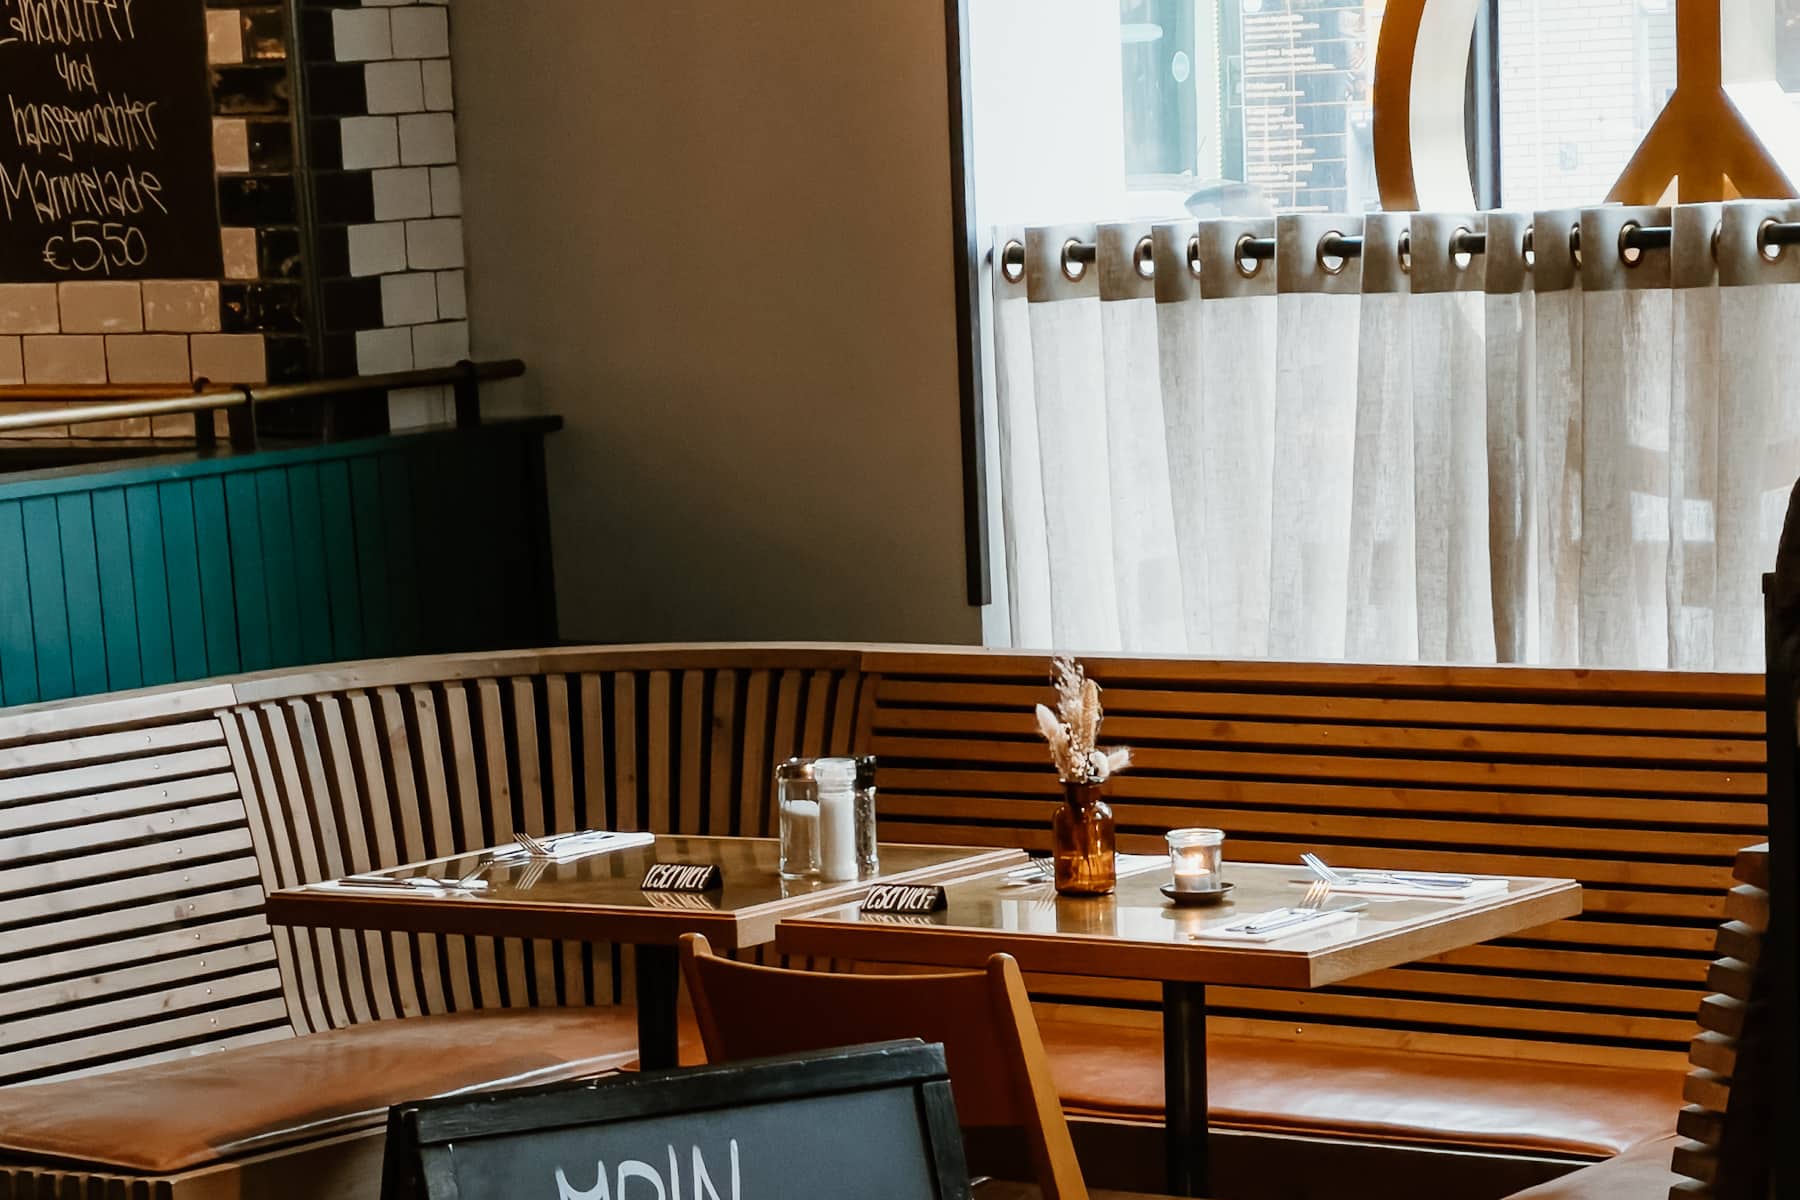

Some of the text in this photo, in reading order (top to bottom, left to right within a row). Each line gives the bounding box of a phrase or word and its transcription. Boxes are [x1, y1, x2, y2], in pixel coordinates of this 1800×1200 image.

[8, 92, 157, 162] hausgemachter
[0, 162, 168, 224] Marmelade
[42, 220, 148, 275] €5,50
[642, 864, 713, 889] reserviert
